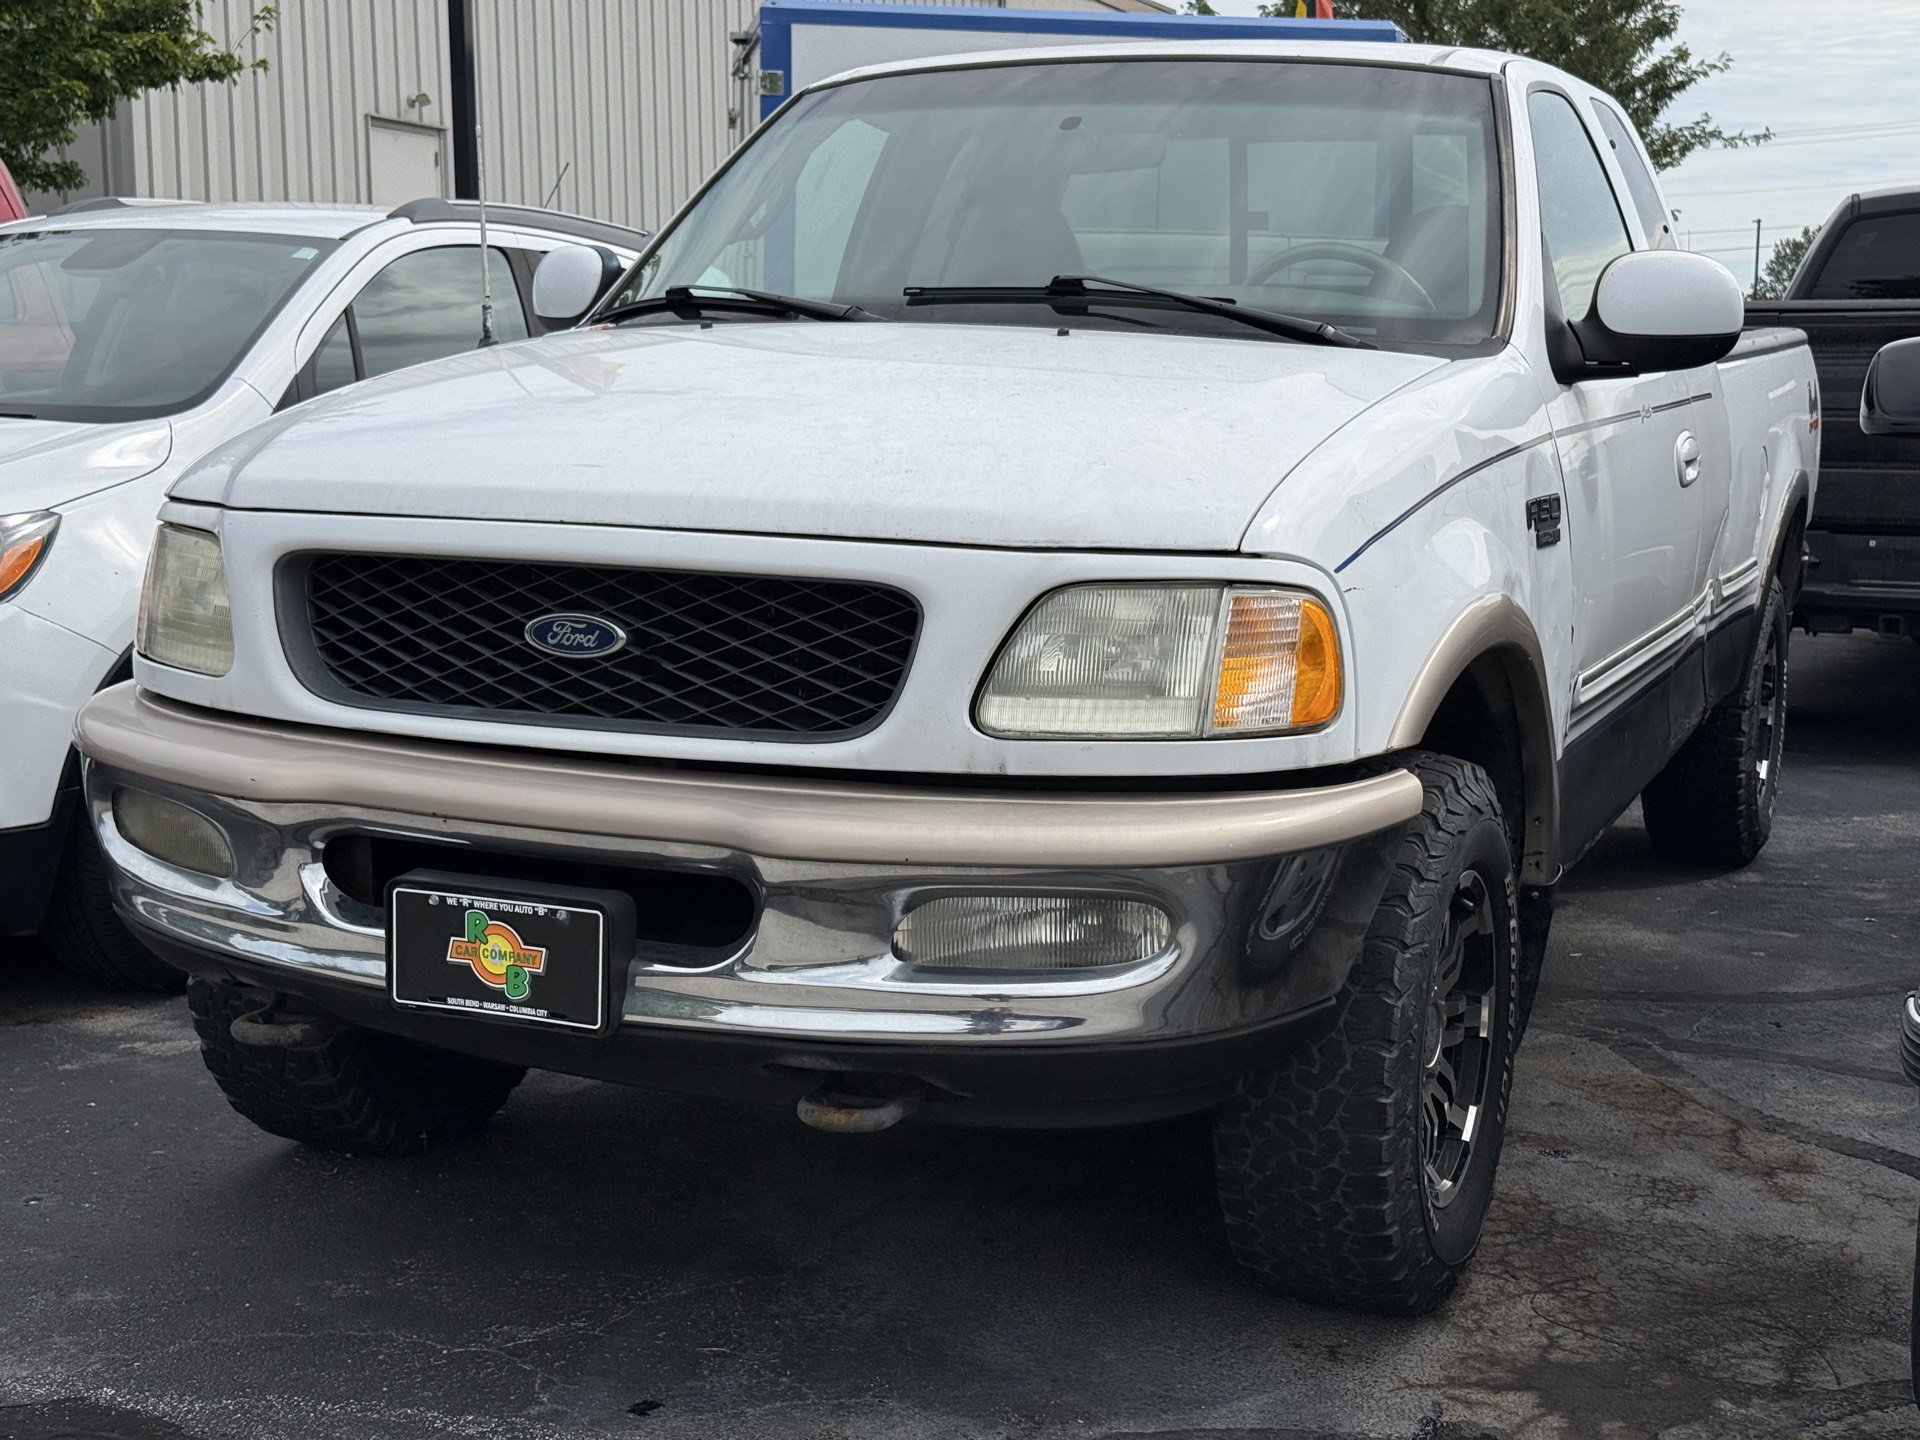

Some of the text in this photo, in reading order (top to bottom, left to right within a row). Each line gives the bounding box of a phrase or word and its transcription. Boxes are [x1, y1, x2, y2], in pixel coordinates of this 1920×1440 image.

[547, 621, 599, 648] Ford
[446, 897, 458, 906] WE
[459, 899, 472, 907] "R"
[473, 901, 498, 910] WHERE
[499, 903, 513, 912] YOU
[514, 905, 533, 915] AUTO
[465, 910, 489, 945] R
[455, 945, 537, 965] CAR COMPANY
[506, 964, 529, 999] B
[447, 997, 548, 1017] SOUTH BEND WARSAW COLUMBIA CITY
